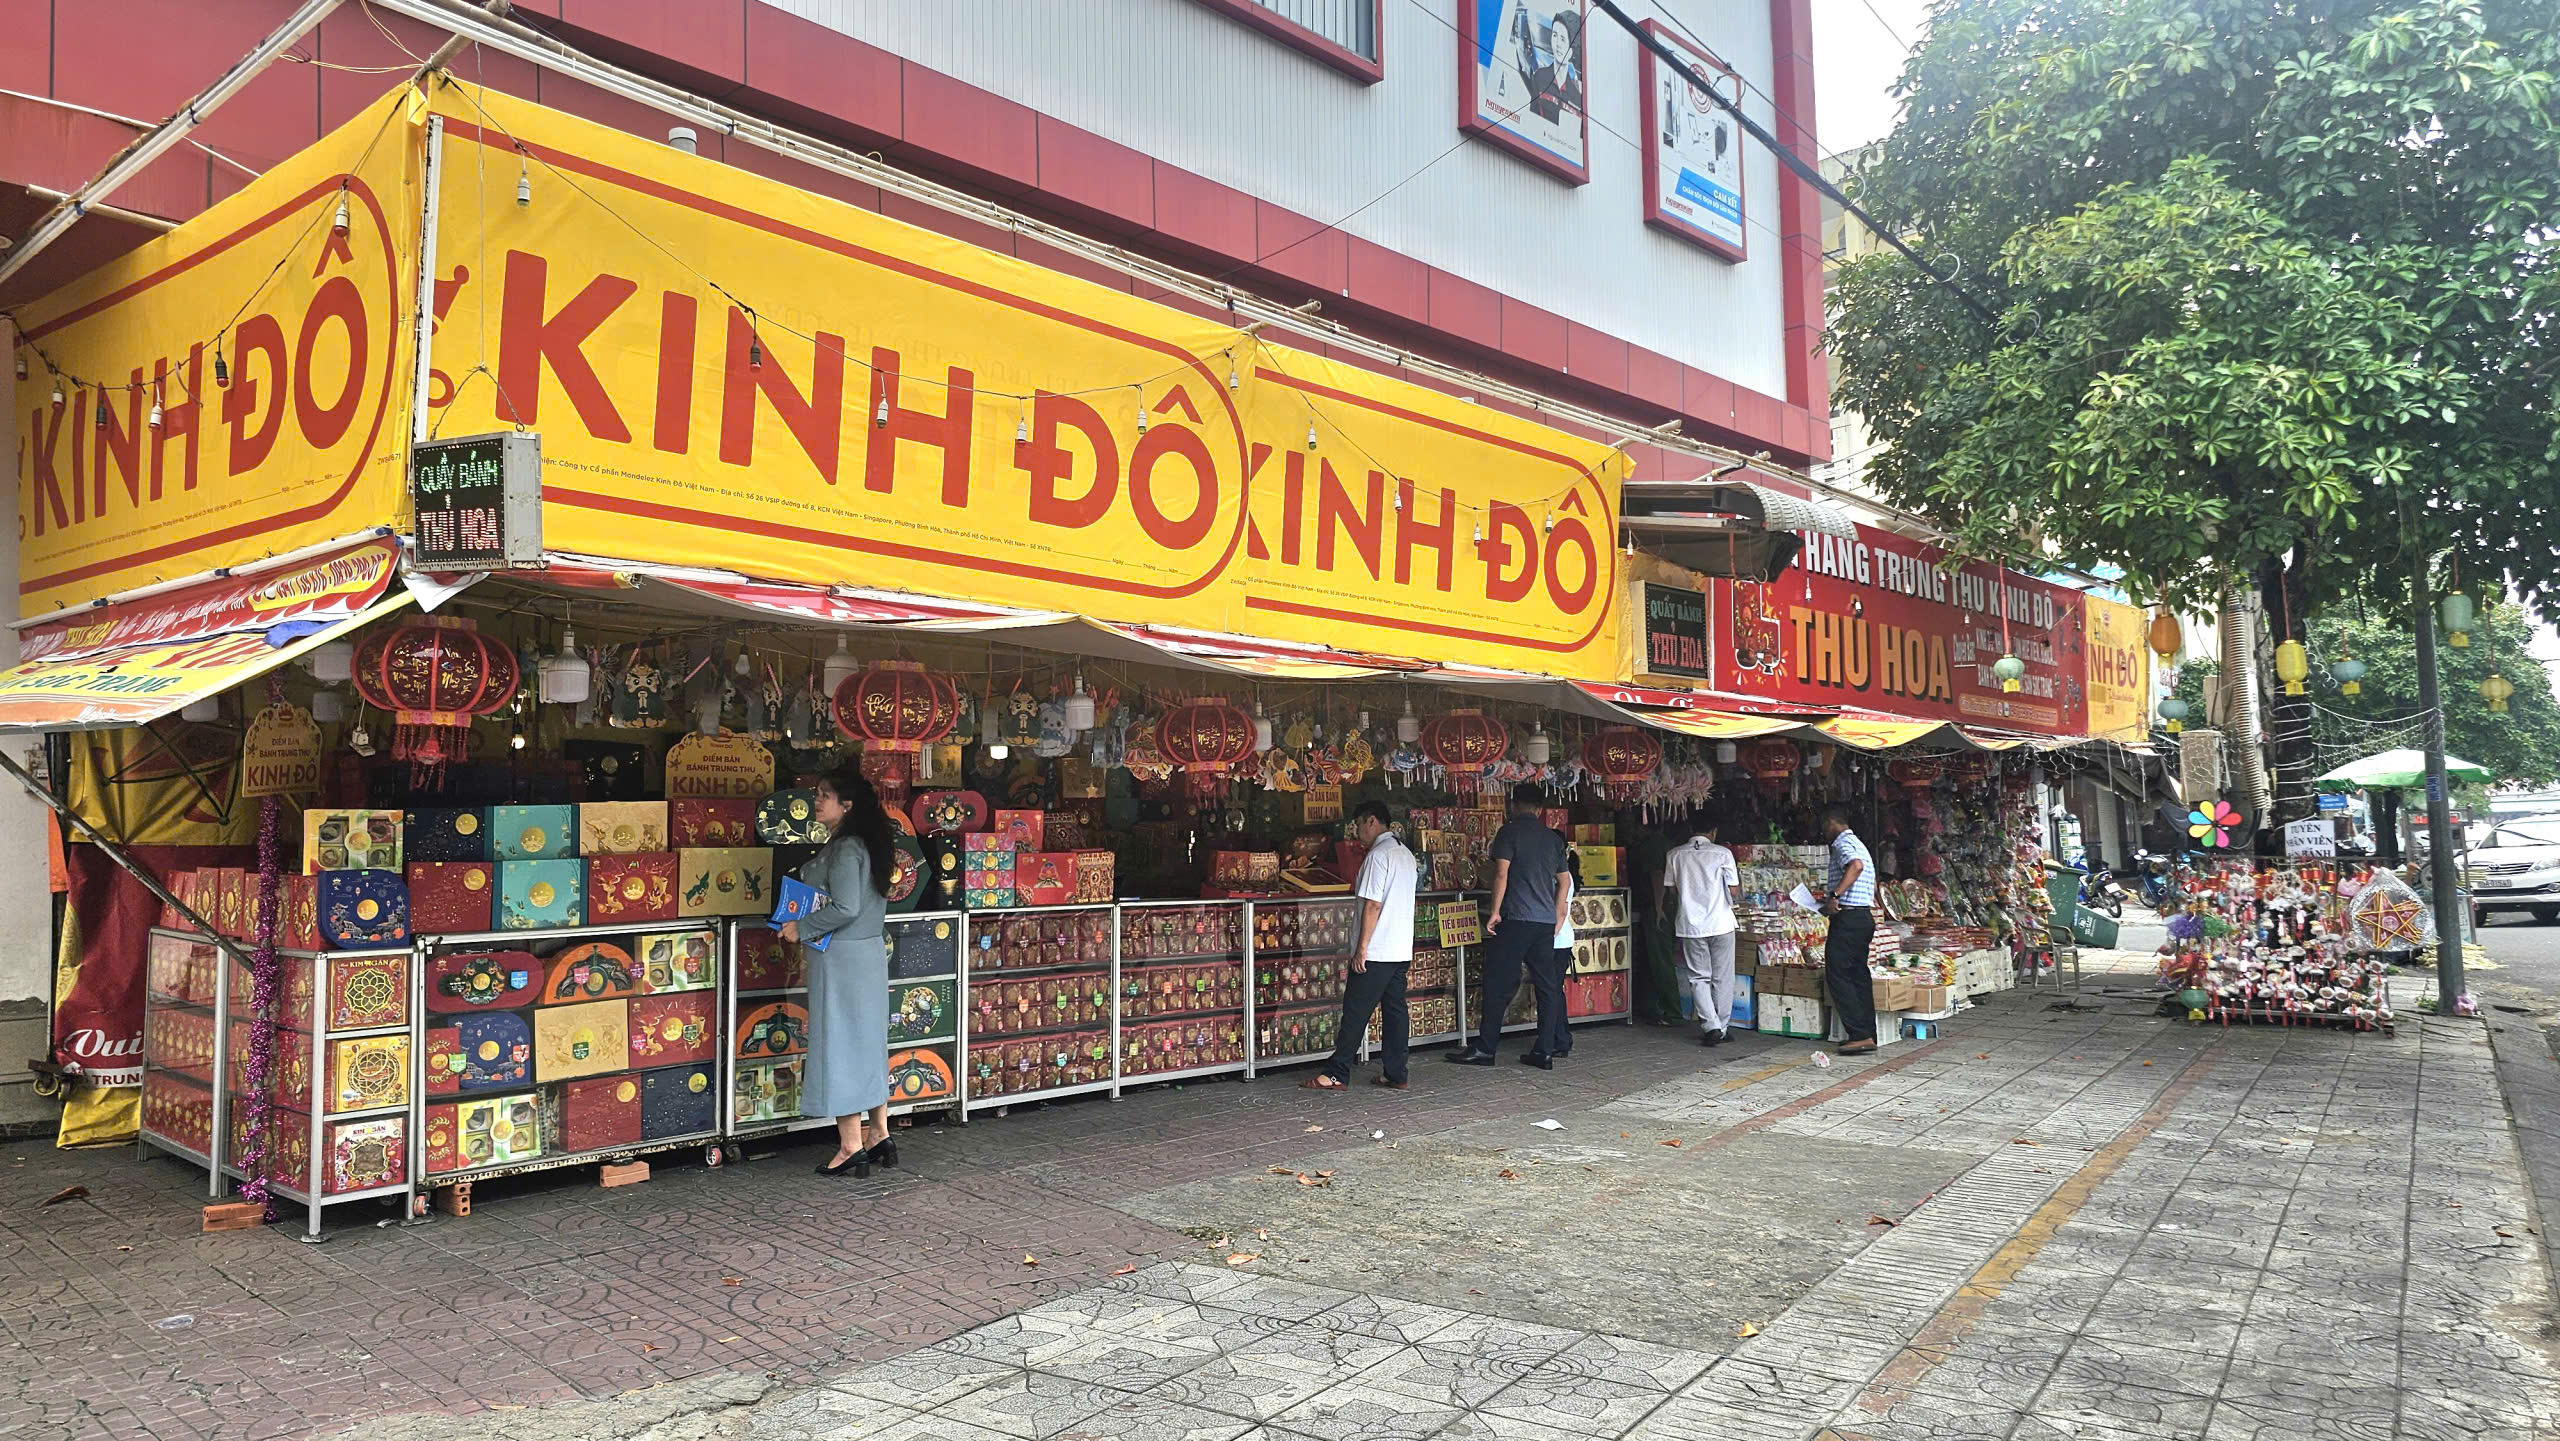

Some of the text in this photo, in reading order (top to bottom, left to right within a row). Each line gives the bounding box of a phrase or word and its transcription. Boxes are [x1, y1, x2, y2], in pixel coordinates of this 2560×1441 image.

[32, 223, 369, 538] KINH ĐÔ
[495, 249, 1219, 551] KINH ĐÔ
[459, 450, 498, 489] BÁNH
[559, 460, 578, 471] Công
[580, 463, 588, 472] ty
[590, 464, 600, 473] Cổ
[602, 468, 619, 478] phần
[621, 471, 655, 483] Mondelez
[656, 476, 671, 486] Kinh
[673, 479, 683, 488] Đô
[684, 482, 698, 492] Việt
[699, 485, 715, 493] Nam
[765, 496, 780, 504] VSIP
[817, 506, 830, 514] KCN
[845, 510, 858, 518] Nam
[863, 514, 894, 526] Singapore,
[460, 507, 499, 550] HOA
[1477, 487, 1597, 615] ĐÔ
[1874, 549, 1945, 603] TRUNG
[1950, 571, 1984, 613] THU
[2033, 590, 2053, 631] ĐÔ
[1677, 600, 1702, 623] BÁNH
[1680, 635, 1705, 670] HOA
[1789, 594, 1869, 688] THỦ
[1879, 623, 1952, 700] HOA
[2117, 644, 2138, 688] ĐÔ
[247, 757, 317, 787] KINH ĐÔ
[686, 762, 756, 773] BÁNH TRUNG THU
[724, 753, 740, 763] BÁN
[672, 773, 768, 796] KINH ĐÔ
[2307, 834, 2333, 845] VIÊN
[64, 1029, 145, 1058] Vui
[91, 1072, 144, 1086] TRUN
